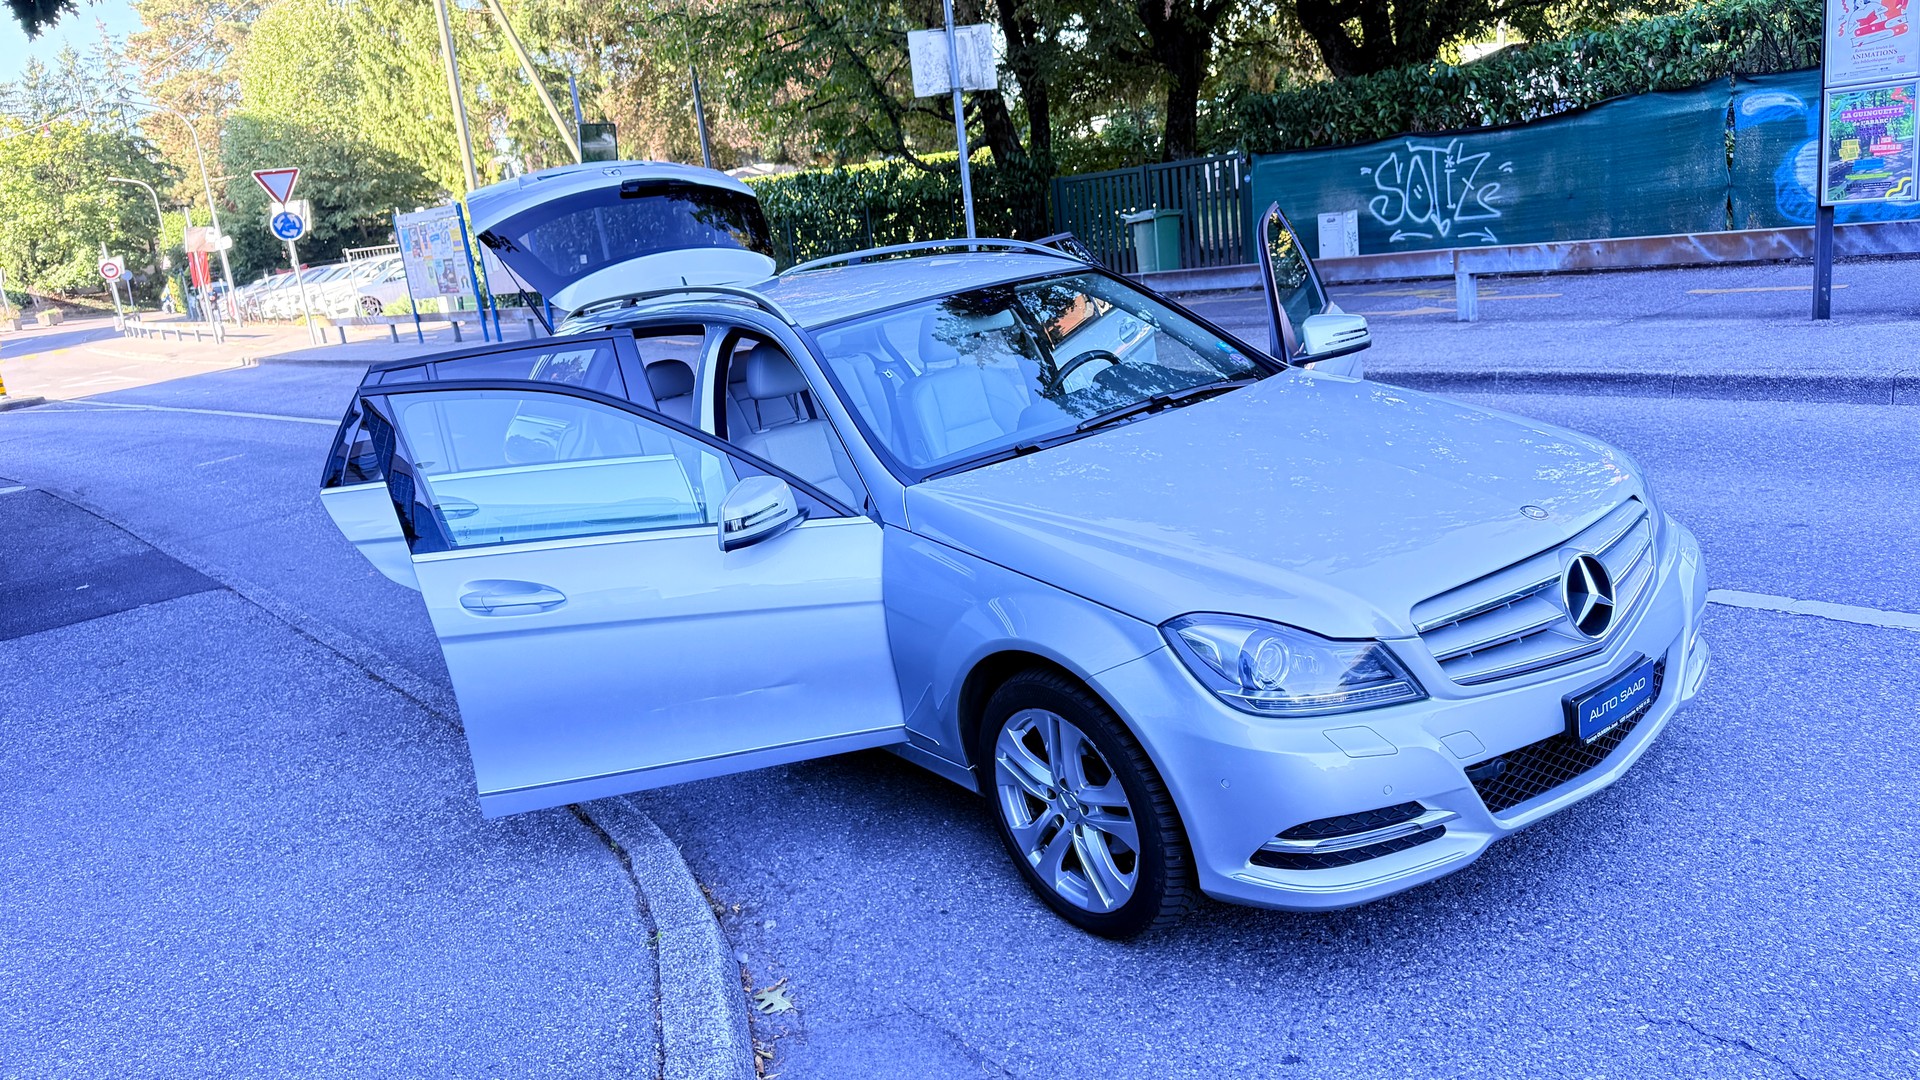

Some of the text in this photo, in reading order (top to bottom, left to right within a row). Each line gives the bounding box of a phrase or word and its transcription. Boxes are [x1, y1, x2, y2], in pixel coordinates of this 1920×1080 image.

[1851, 49, 1898, 60] ANIMATIONS
[1852, 107, 1904, 118] GUINGUETTE
[1589, 696, 1618, 722] AUTO
[1620, 677, 1646, 702] SAAD
